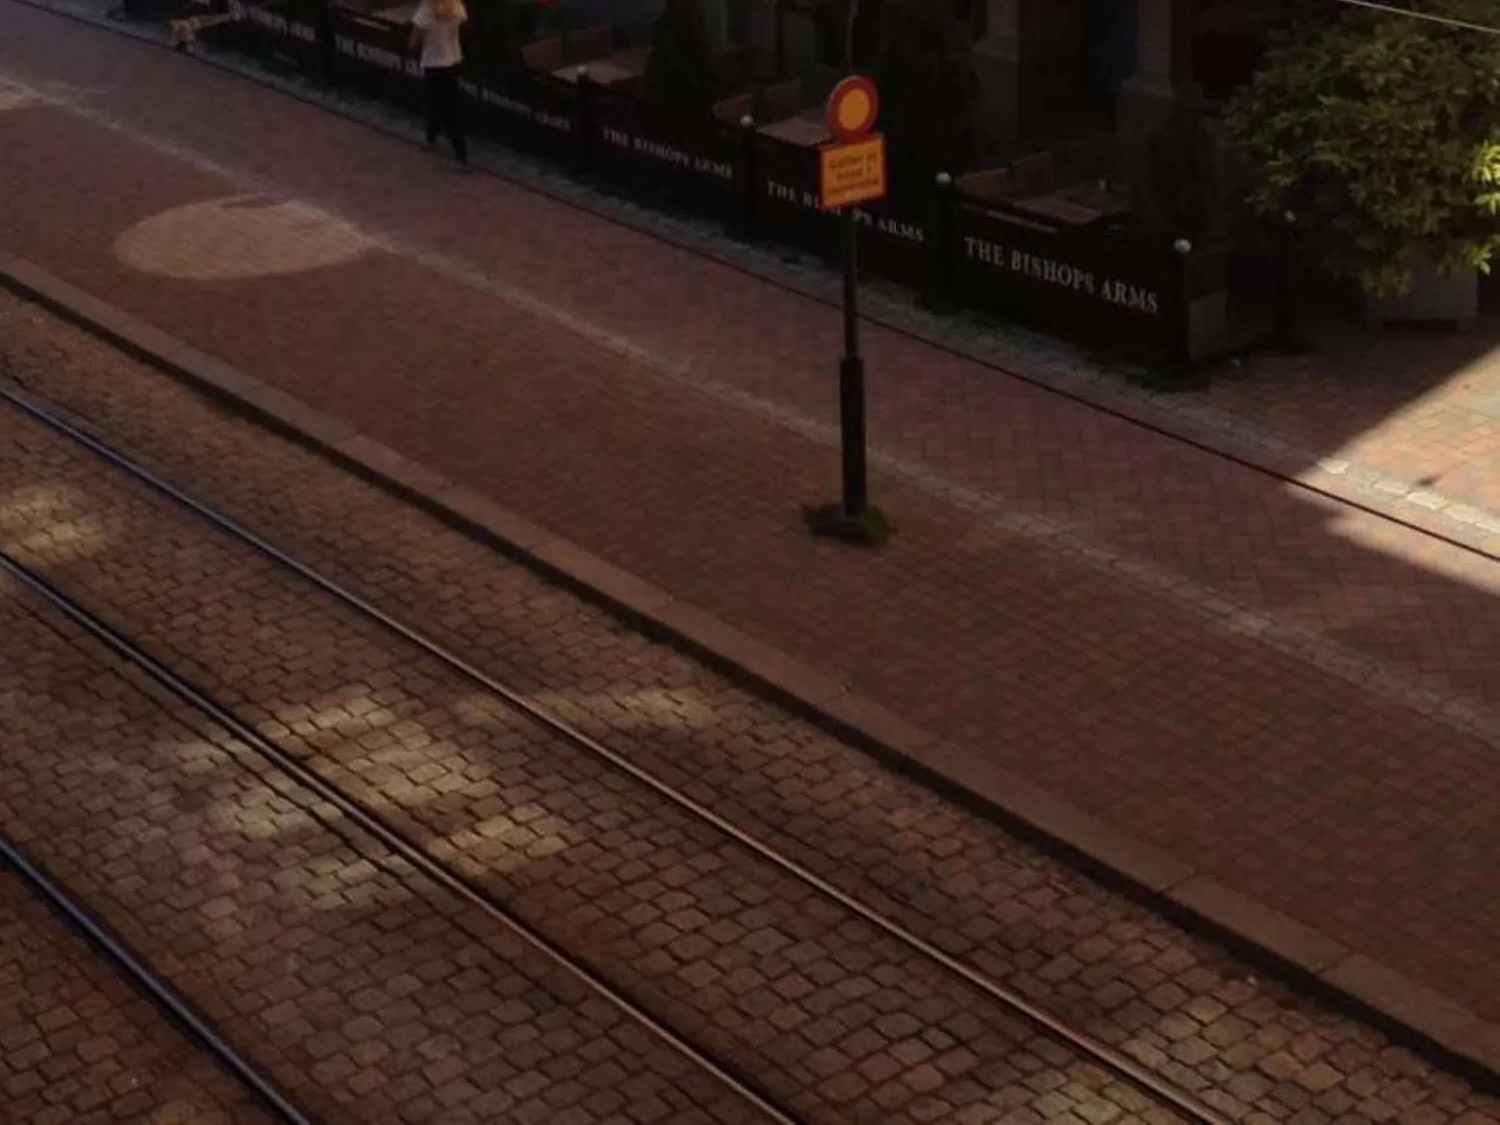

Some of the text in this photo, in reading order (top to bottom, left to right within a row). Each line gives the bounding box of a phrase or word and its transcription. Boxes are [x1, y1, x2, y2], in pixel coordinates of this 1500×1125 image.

[963, 235, 1159, 315] THE BISHOPS ARMS
